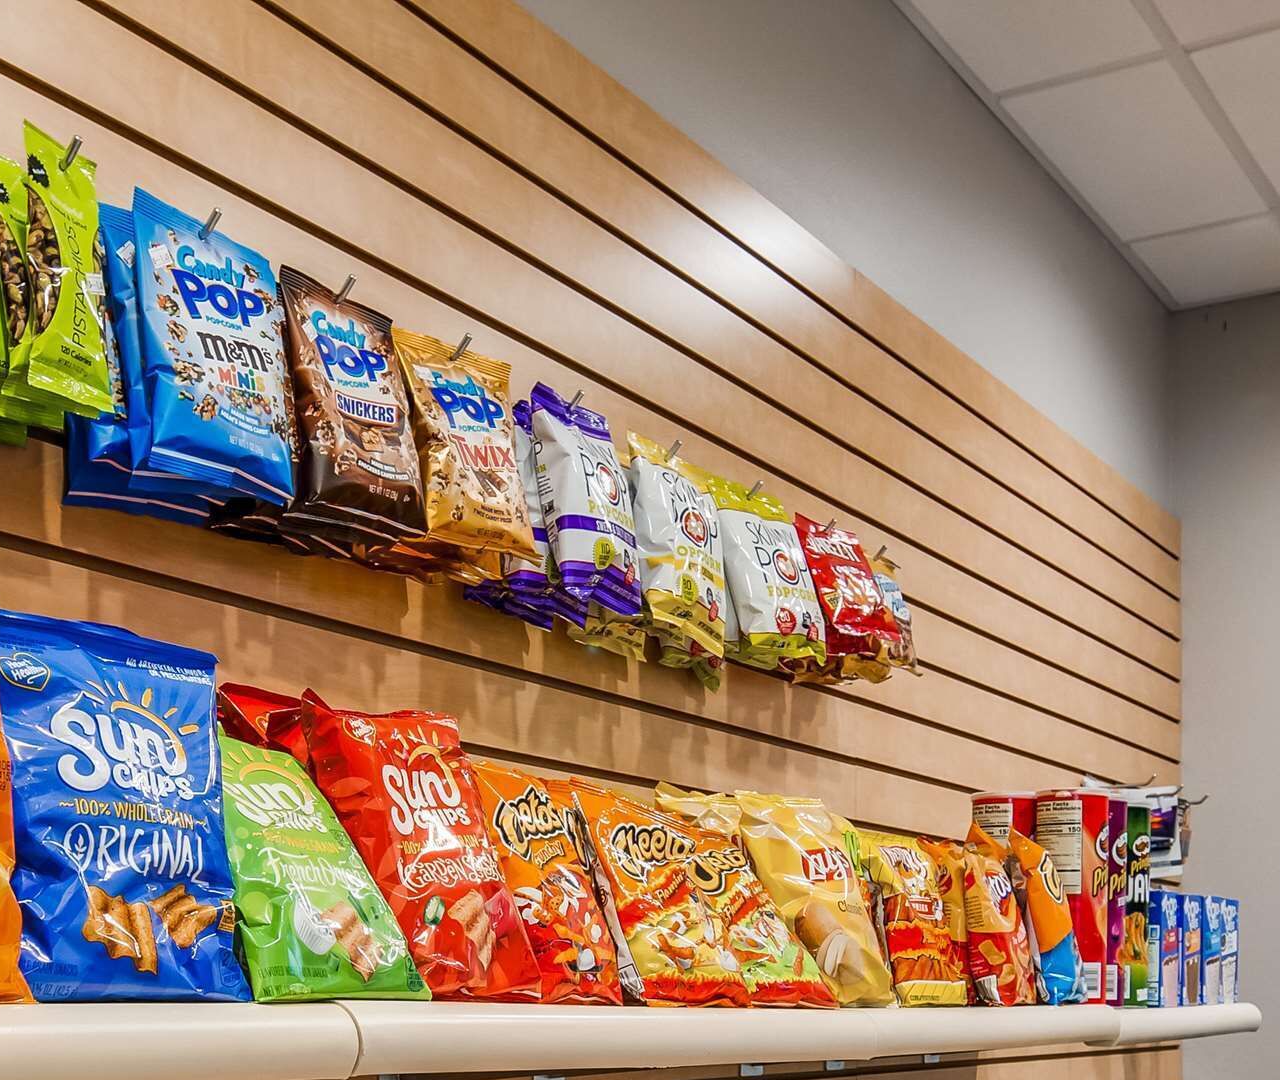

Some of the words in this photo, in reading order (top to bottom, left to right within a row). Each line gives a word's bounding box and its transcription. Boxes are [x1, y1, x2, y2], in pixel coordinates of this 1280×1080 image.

[66, 221, 87, 349] PISTACHIOS
[177, 245, 245, 290] Candy
[171, 269, 265, 327] POP
[311, 311, 366, 349] Candy
[70, 350, 92, 368] Calories
[316, 335, 387, 382] POP
[432, 371, 485, 397] Candy
[337, 395, 395, 423] SNICKERS
[432, 387, 505, 428] POP
[451, 434, 517, 473] TWIX
[754, 546, 808, 588] POP
[7, 658, 33, 673] Heart
[176, 667, 209, 678] FLAVORS
[51, 708, 188, 792] Sun
[113, 763, 195, 801] CHIPS
[382, 764, 461, 836] Sun
[74, 798, 111, 816] 100%
[115, 803, 159, 822] WHOLE
[159, 808, 195, 830] GRAIN
[413, 808, 471, 830] CHIPS
[64, 823, 209, 887] ORIGINAL
[258, 848, 323, 888] French
[808, 847, 852, 881] Lay's
[838, 898, 863, 916] Classic
